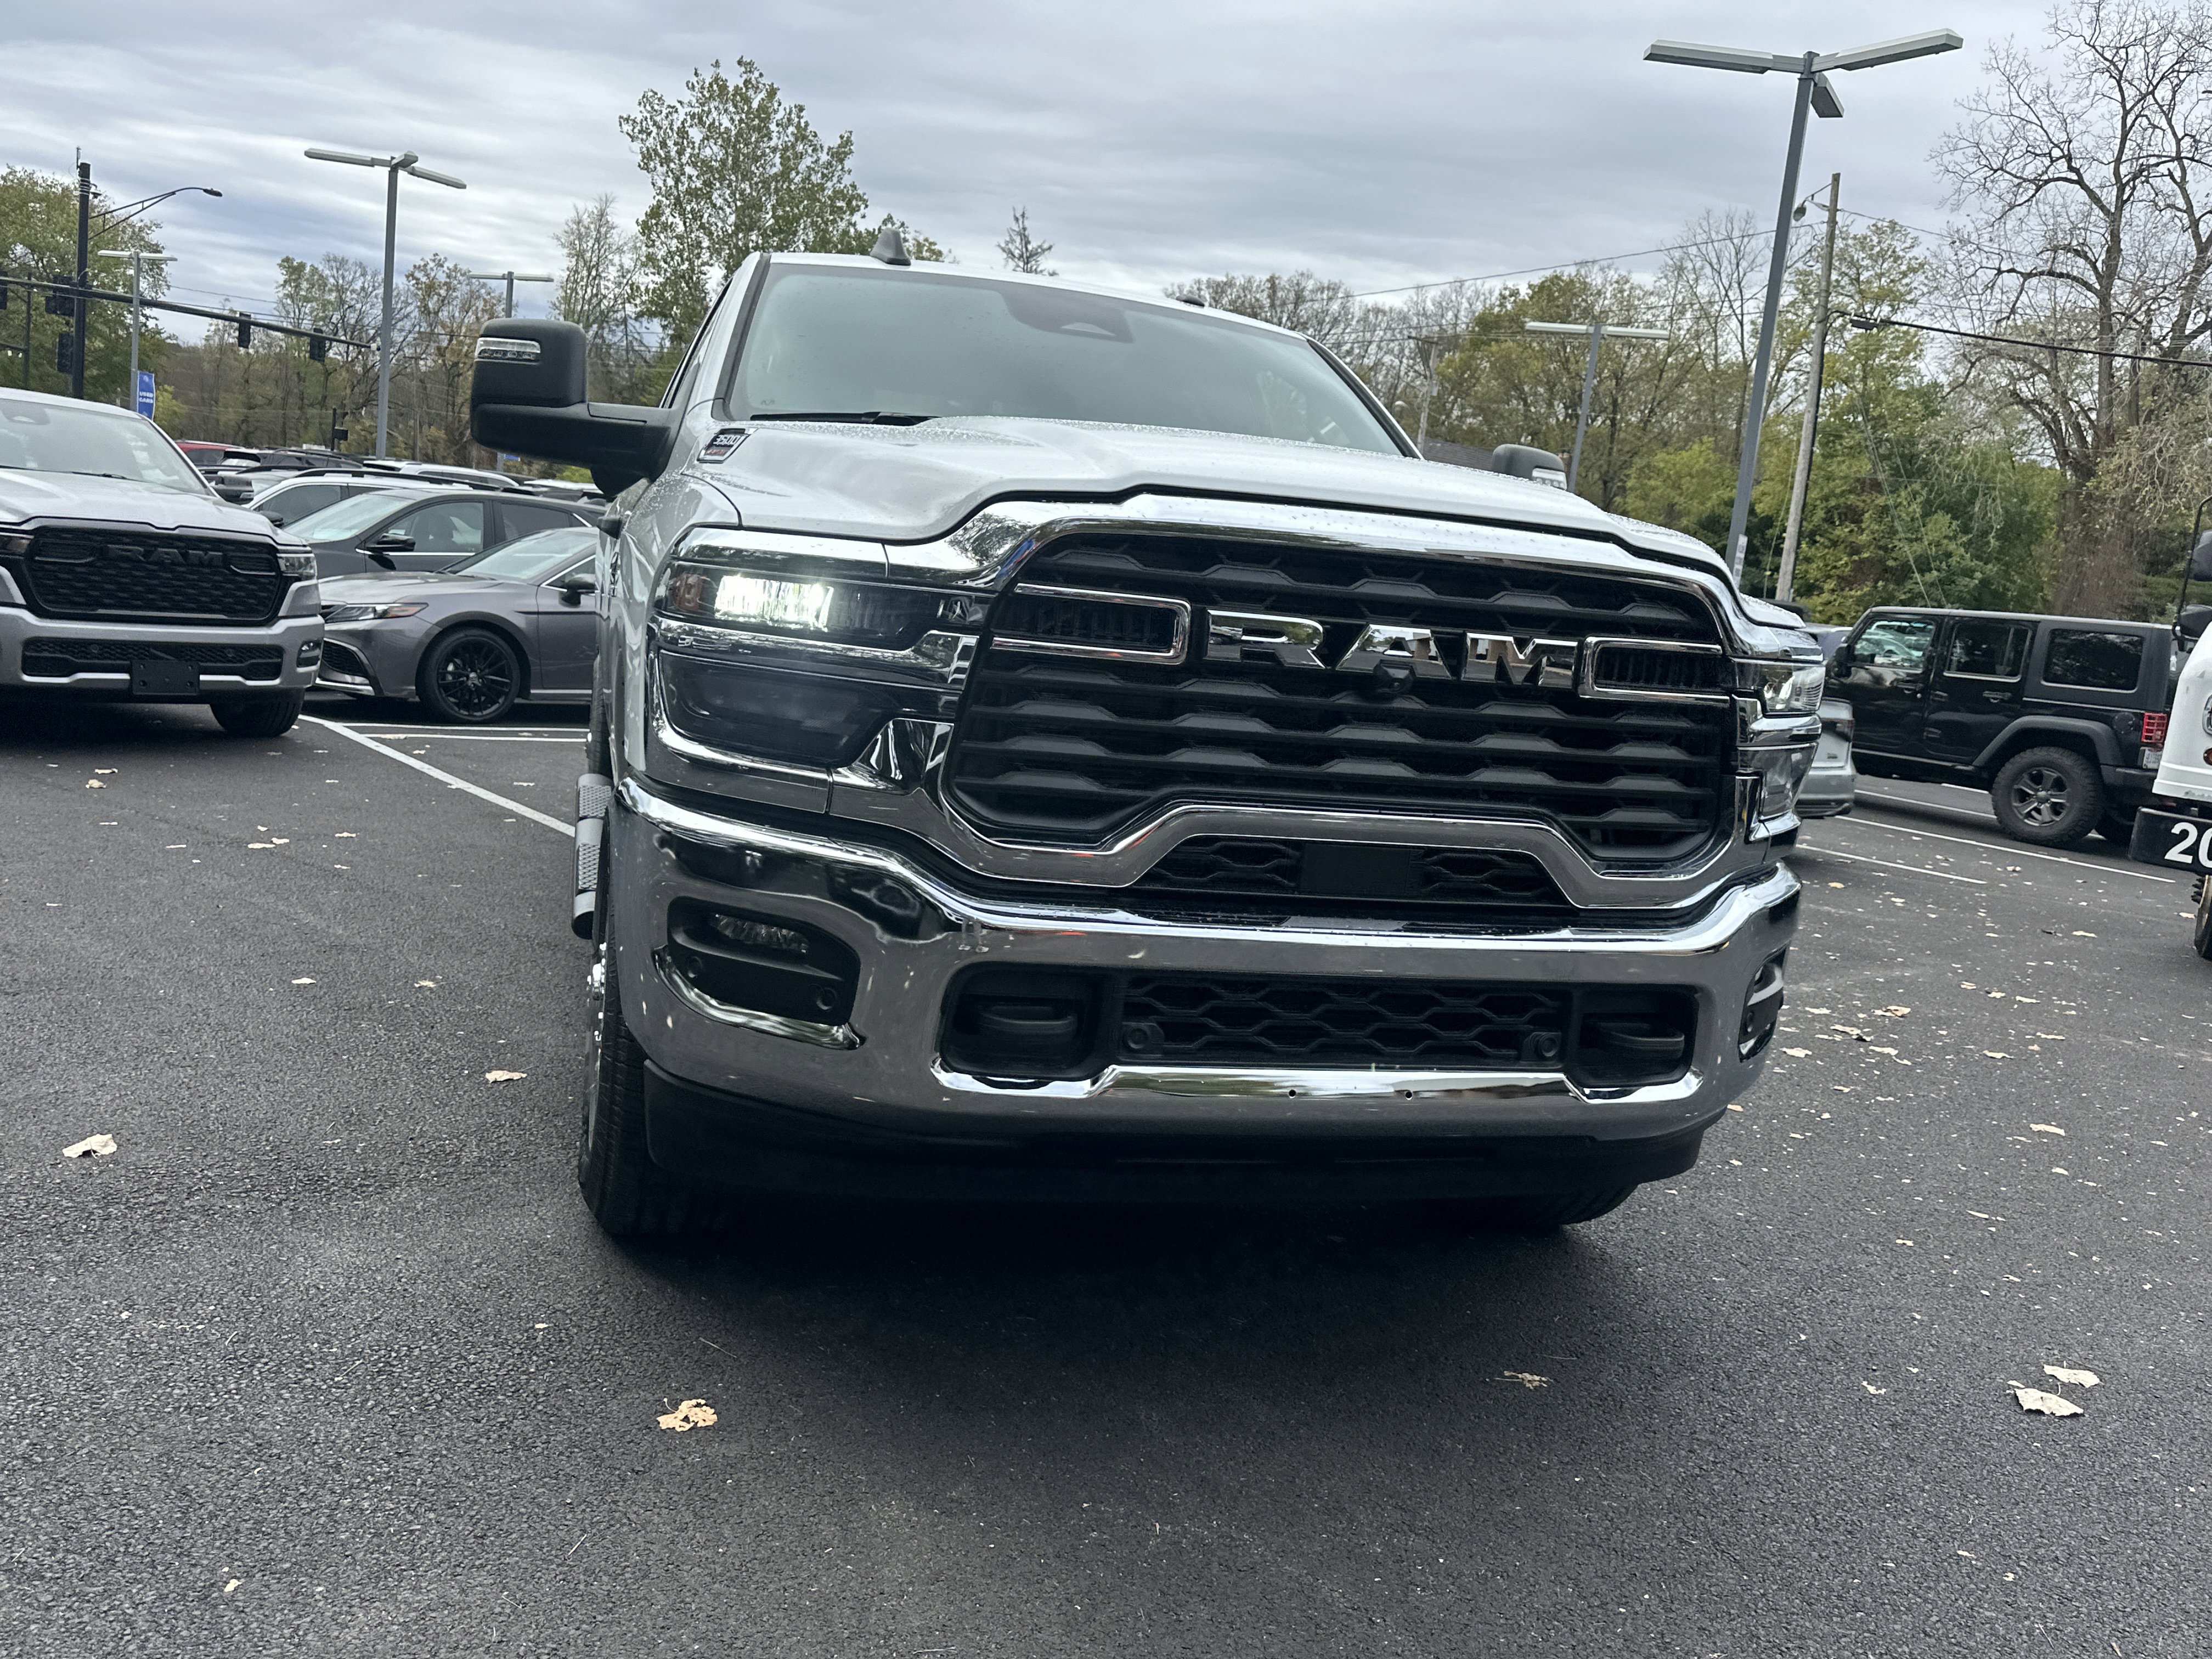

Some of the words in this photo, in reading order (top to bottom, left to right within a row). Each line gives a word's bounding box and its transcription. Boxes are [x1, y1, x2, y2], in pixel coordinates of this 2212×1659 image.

[713, 434, 741, 445] 3500
[107, 544, 223, 566] RAM
[1207, 609, 1578, 689] RAM
